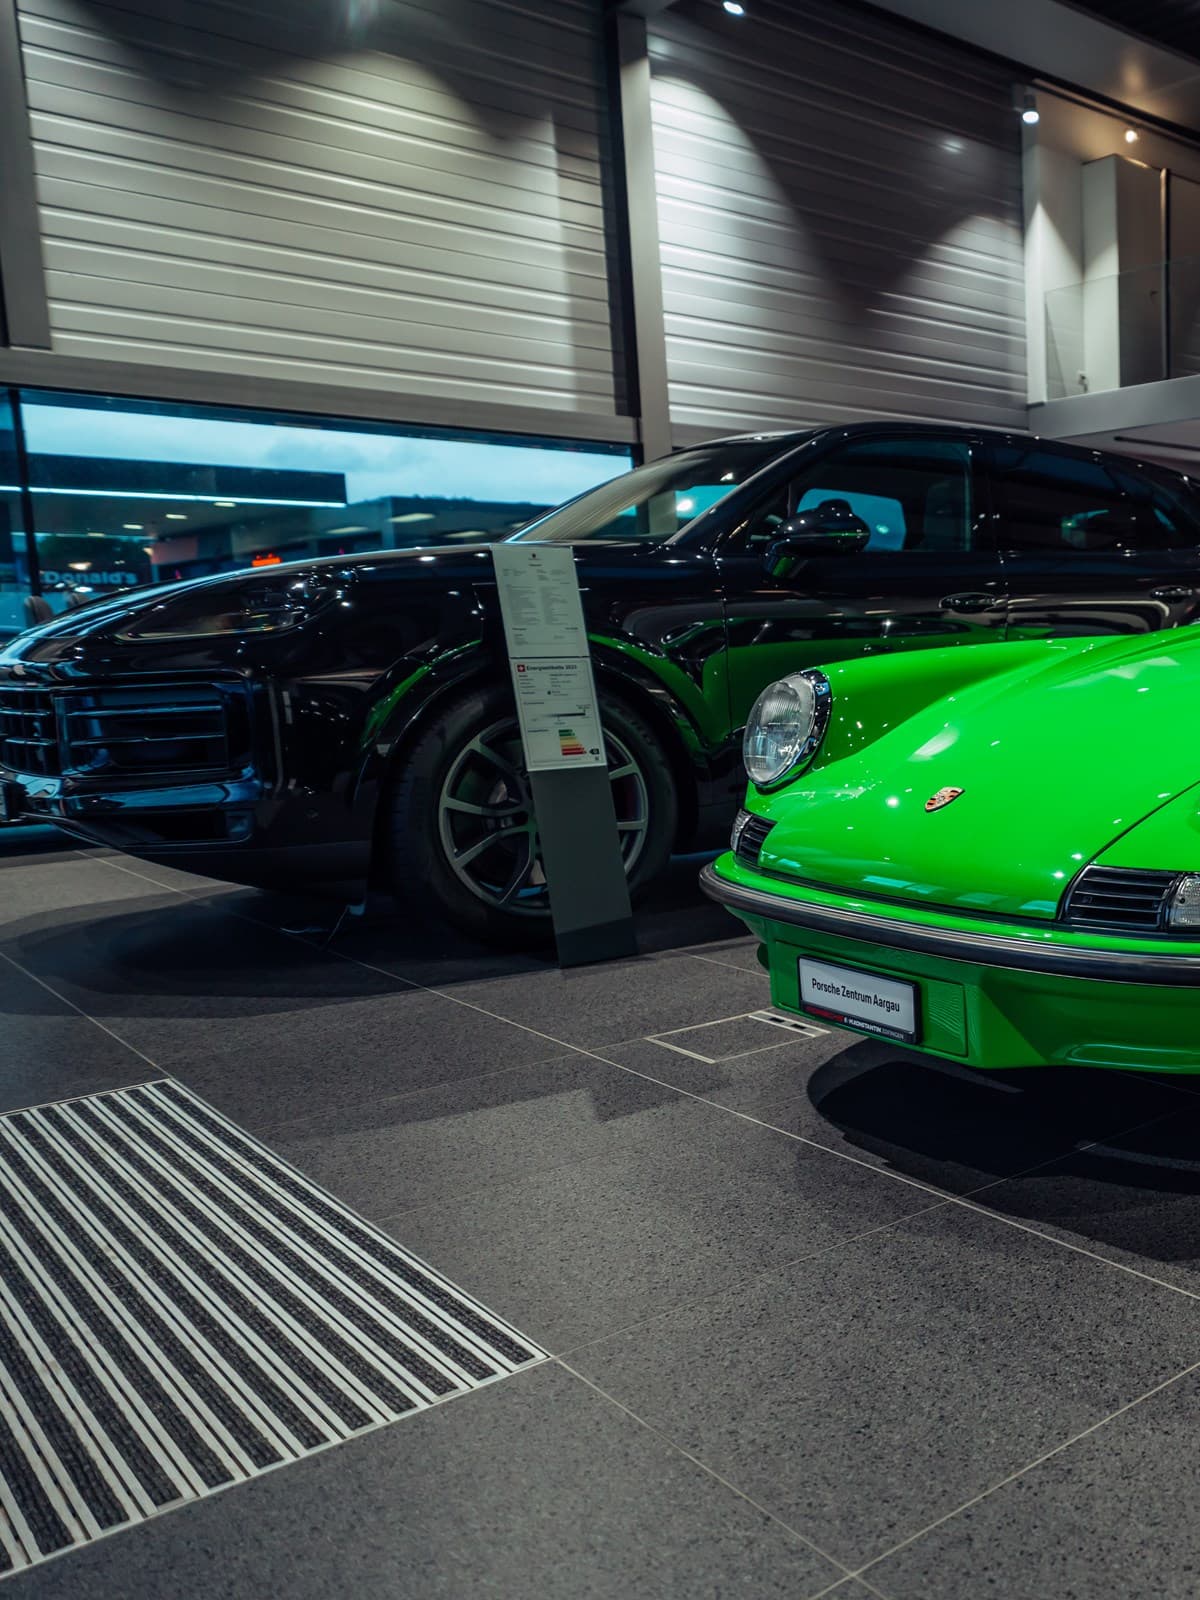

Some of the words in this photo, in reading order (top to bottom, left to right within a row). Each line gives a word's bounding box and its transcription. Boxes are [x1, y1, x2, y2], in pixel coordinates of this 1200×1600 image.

[40, 570, 138, 585] Donald's
[811, 977, 840, 996] Porsche
[841, 985, 872, 1005] Zentrum
[873, 993, 900, 1013] Aargau
